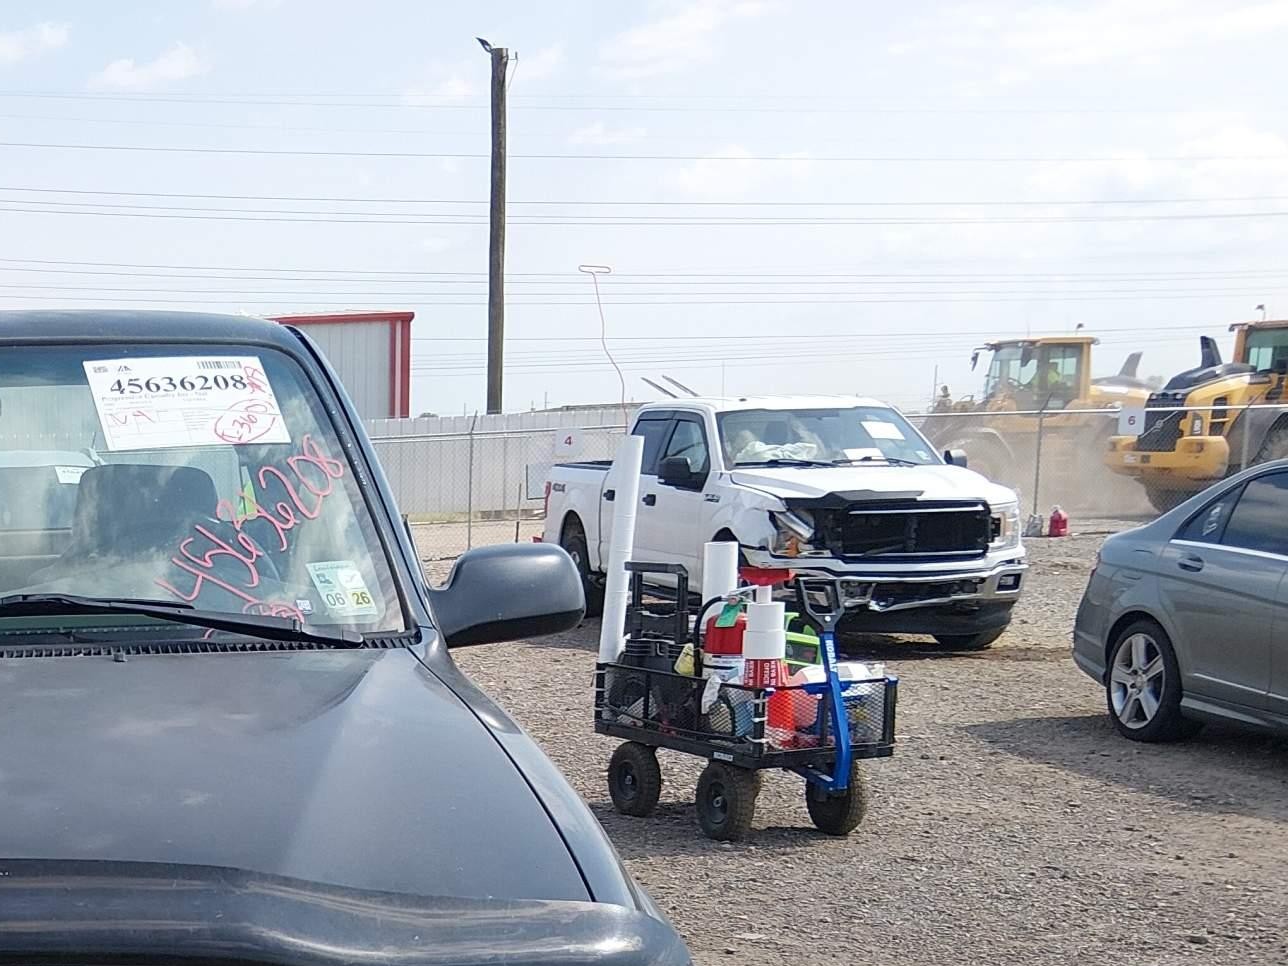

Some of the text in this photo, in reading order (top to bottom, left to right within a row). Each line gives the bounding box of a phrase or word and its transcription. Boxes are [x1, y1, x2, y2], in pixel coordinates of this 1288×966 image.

[110, 374, 248, 395] 45636208
[1128, 415, 1136, 426] 6
[564, 435, 572, 446] 4
[326, 592, 346, 607] 06
[352, 591, 371, 606] 26
[824, 639, 838, 673] KOBALT
